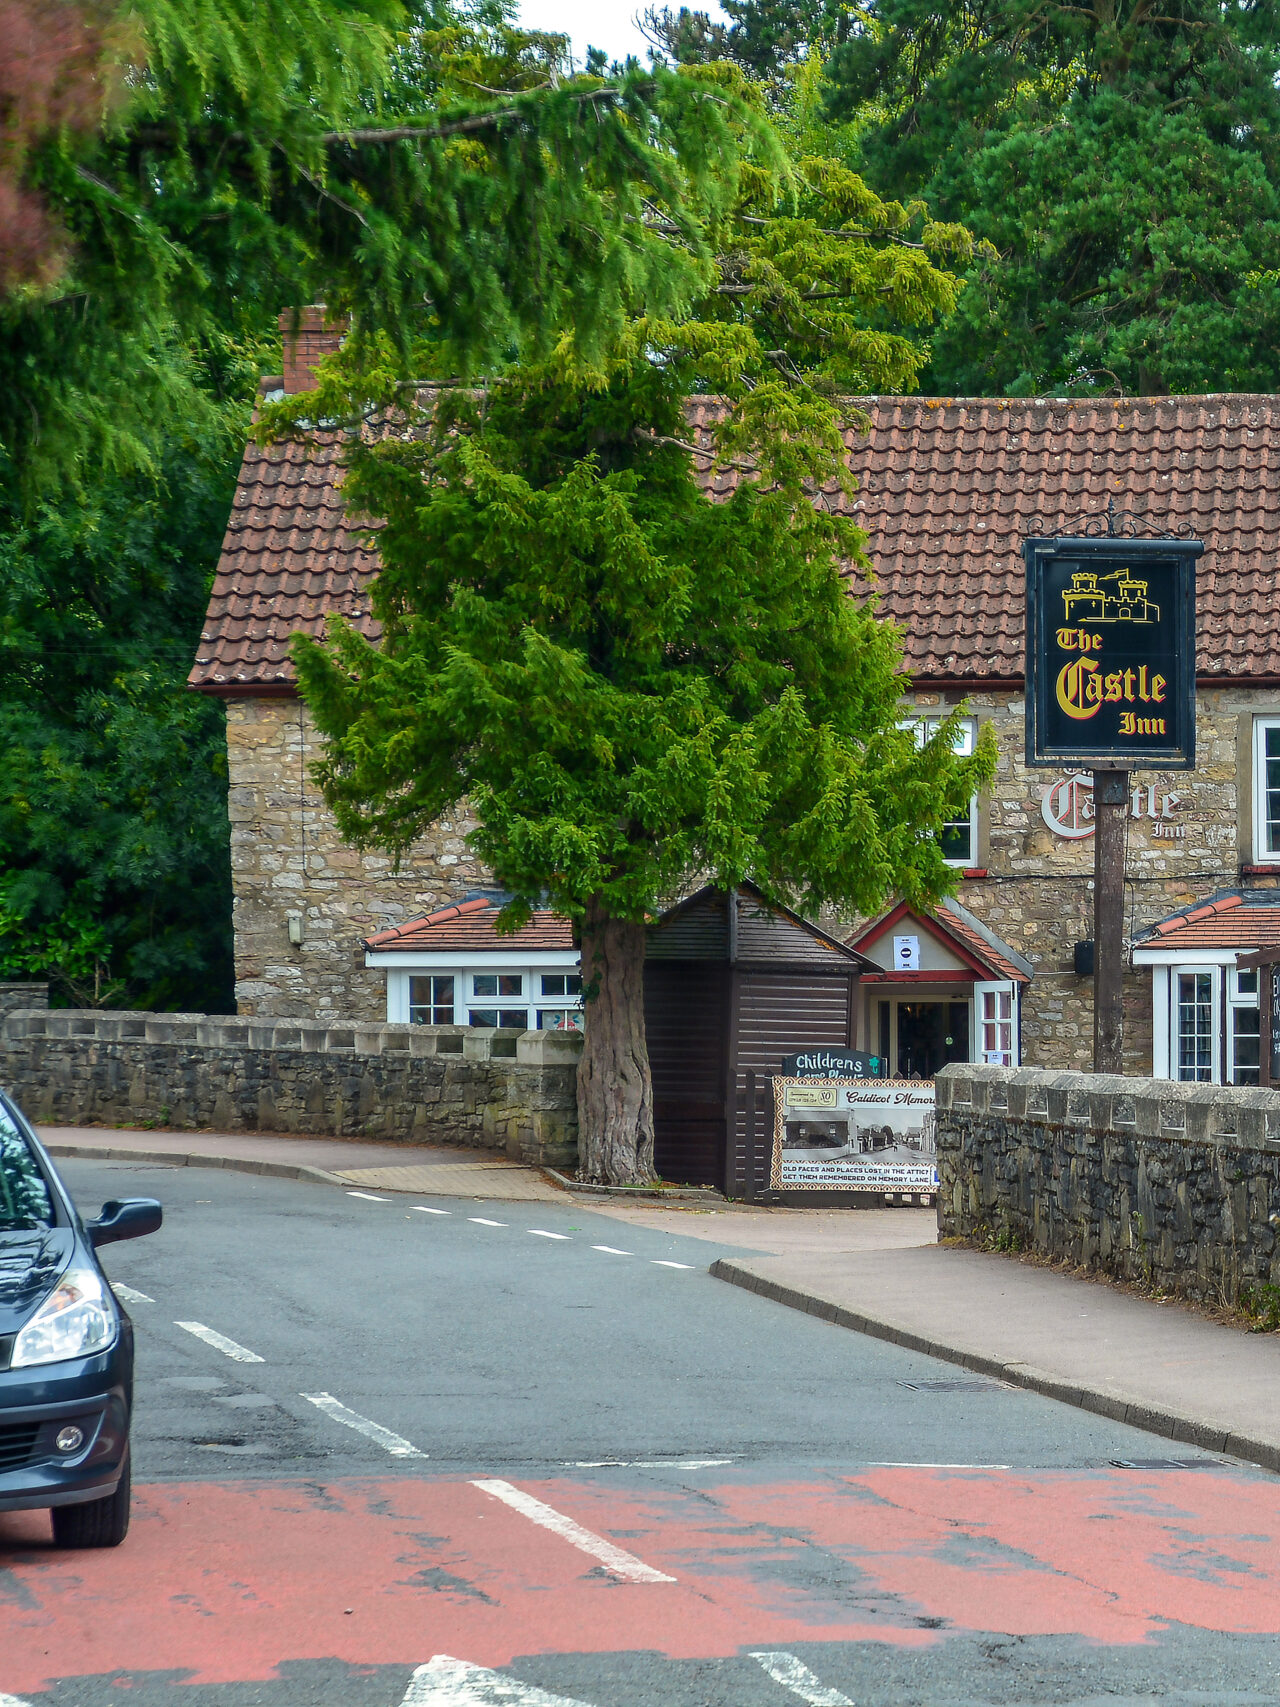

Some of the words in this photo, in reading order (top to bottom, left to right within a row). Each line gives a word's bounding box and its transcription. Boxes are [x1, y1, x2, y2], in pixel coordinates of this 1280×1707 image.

[1056, 628, 1103, 652] The
[1056, 656, 1167, 719] Castle
[1118, 712, 1167, 736] Inn
[1151, 822, 1185, 838] Inn
[796, 1053, 862, 1072] Childrens
[846, 1091, 891, 1104] Caldicot
